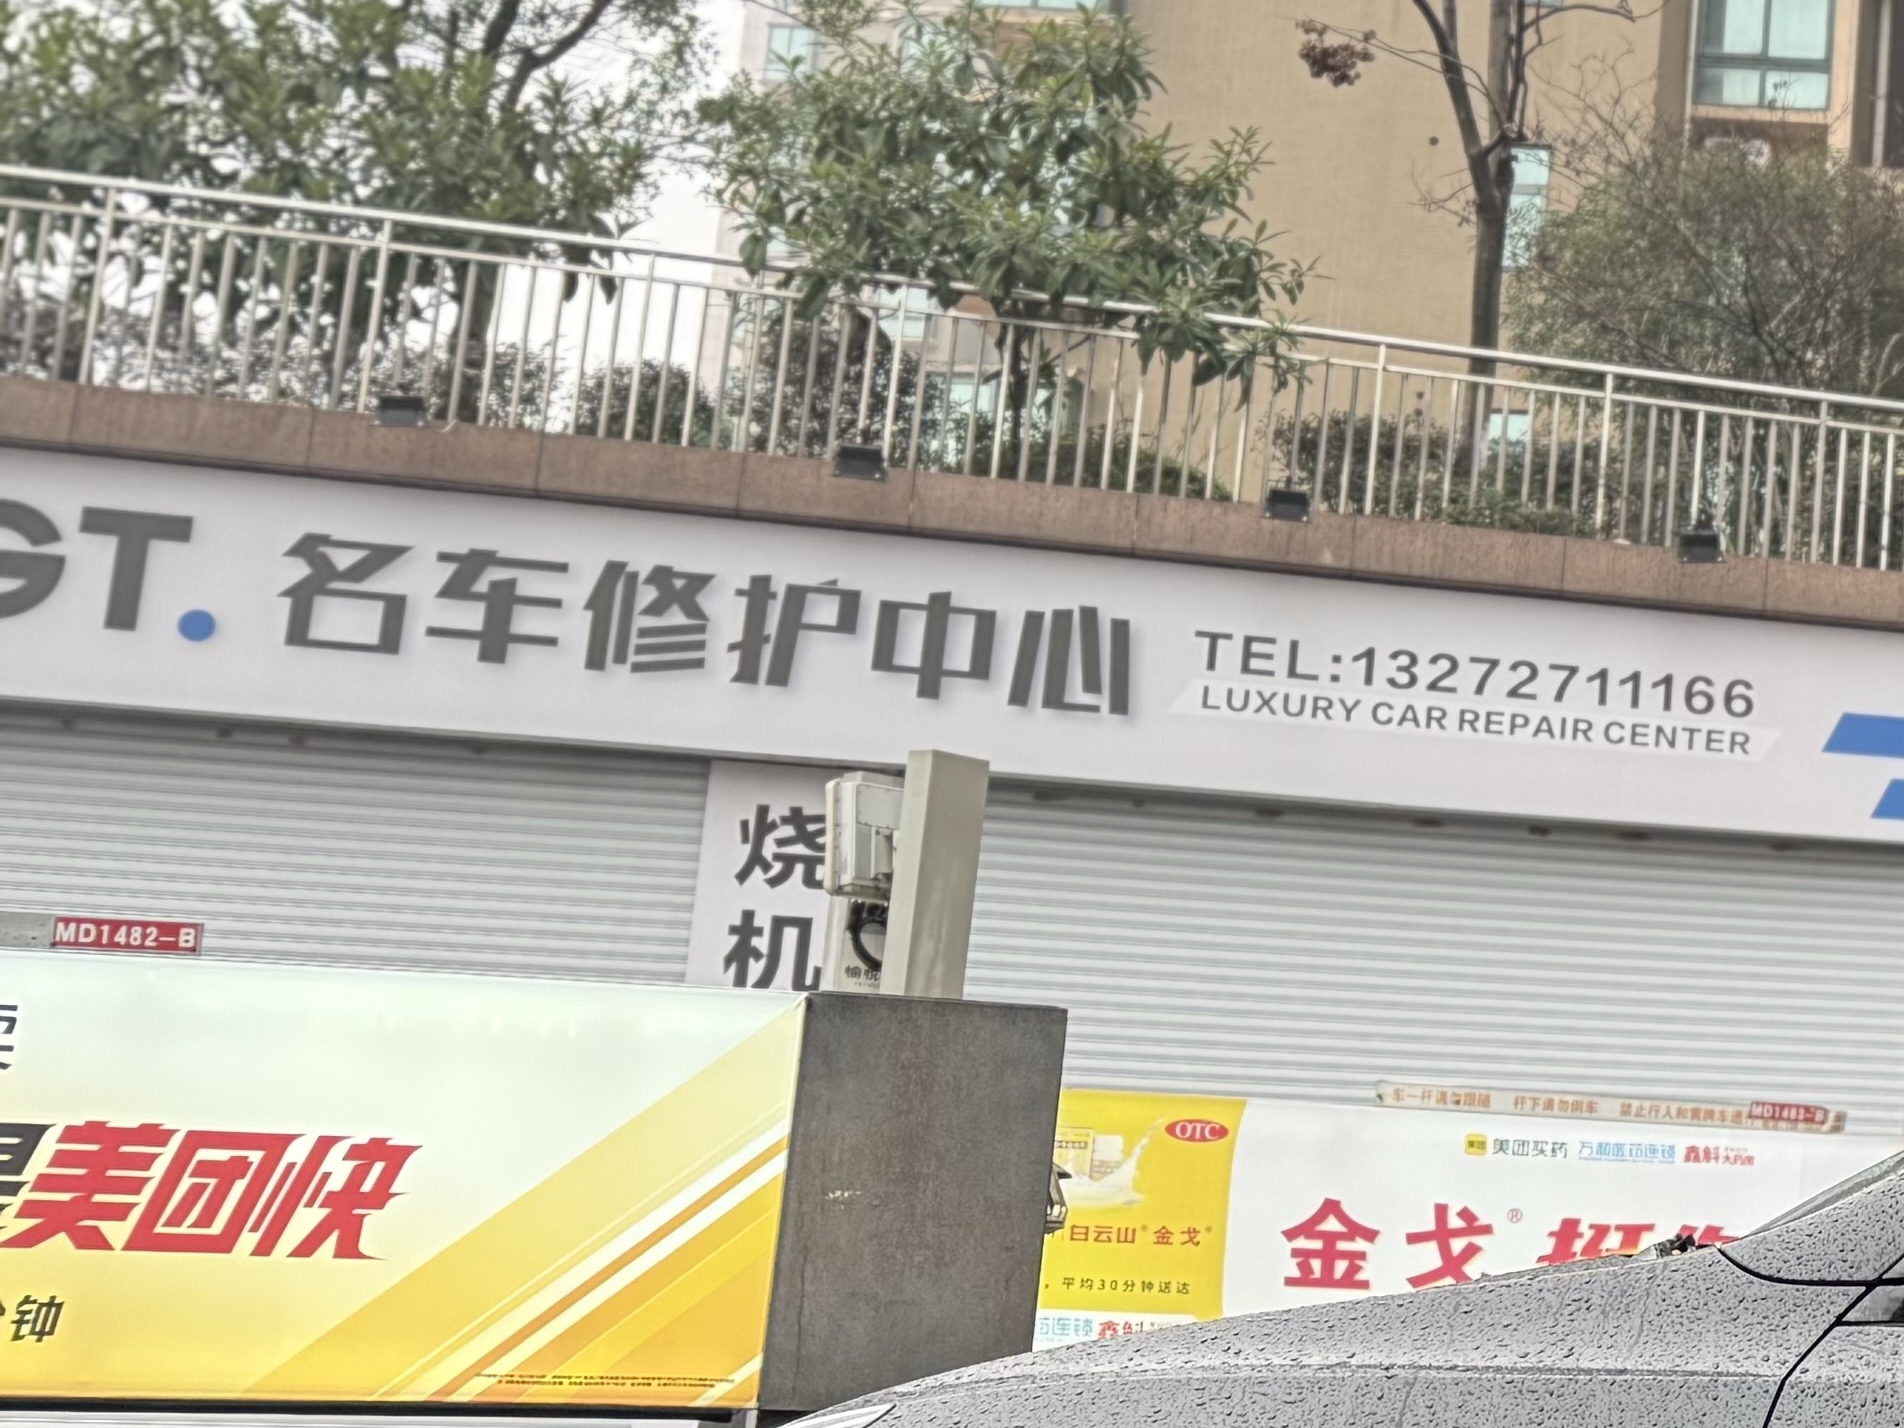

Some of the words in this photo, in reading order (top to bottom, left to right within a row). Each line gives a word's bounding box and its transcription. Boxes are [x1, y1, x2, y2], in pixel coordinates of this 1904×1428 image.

[277, 533, 1131, 716] 名车修护中心
[1194, 629, 1755, 718] TEL:13272711166
[1200, 684, 1362, 722] LUXURY
[1371, 700, 1448, 731] CAR
[1458, 708, 1595, 743] REPAIR
[1603, 720, 1751, 756] CENTER
[55, 921, 196, 948] MD1482-B
[1175, 1122, 1221, 1140] OTC
[1492, 1138, 1568, 1159] 美团买药
